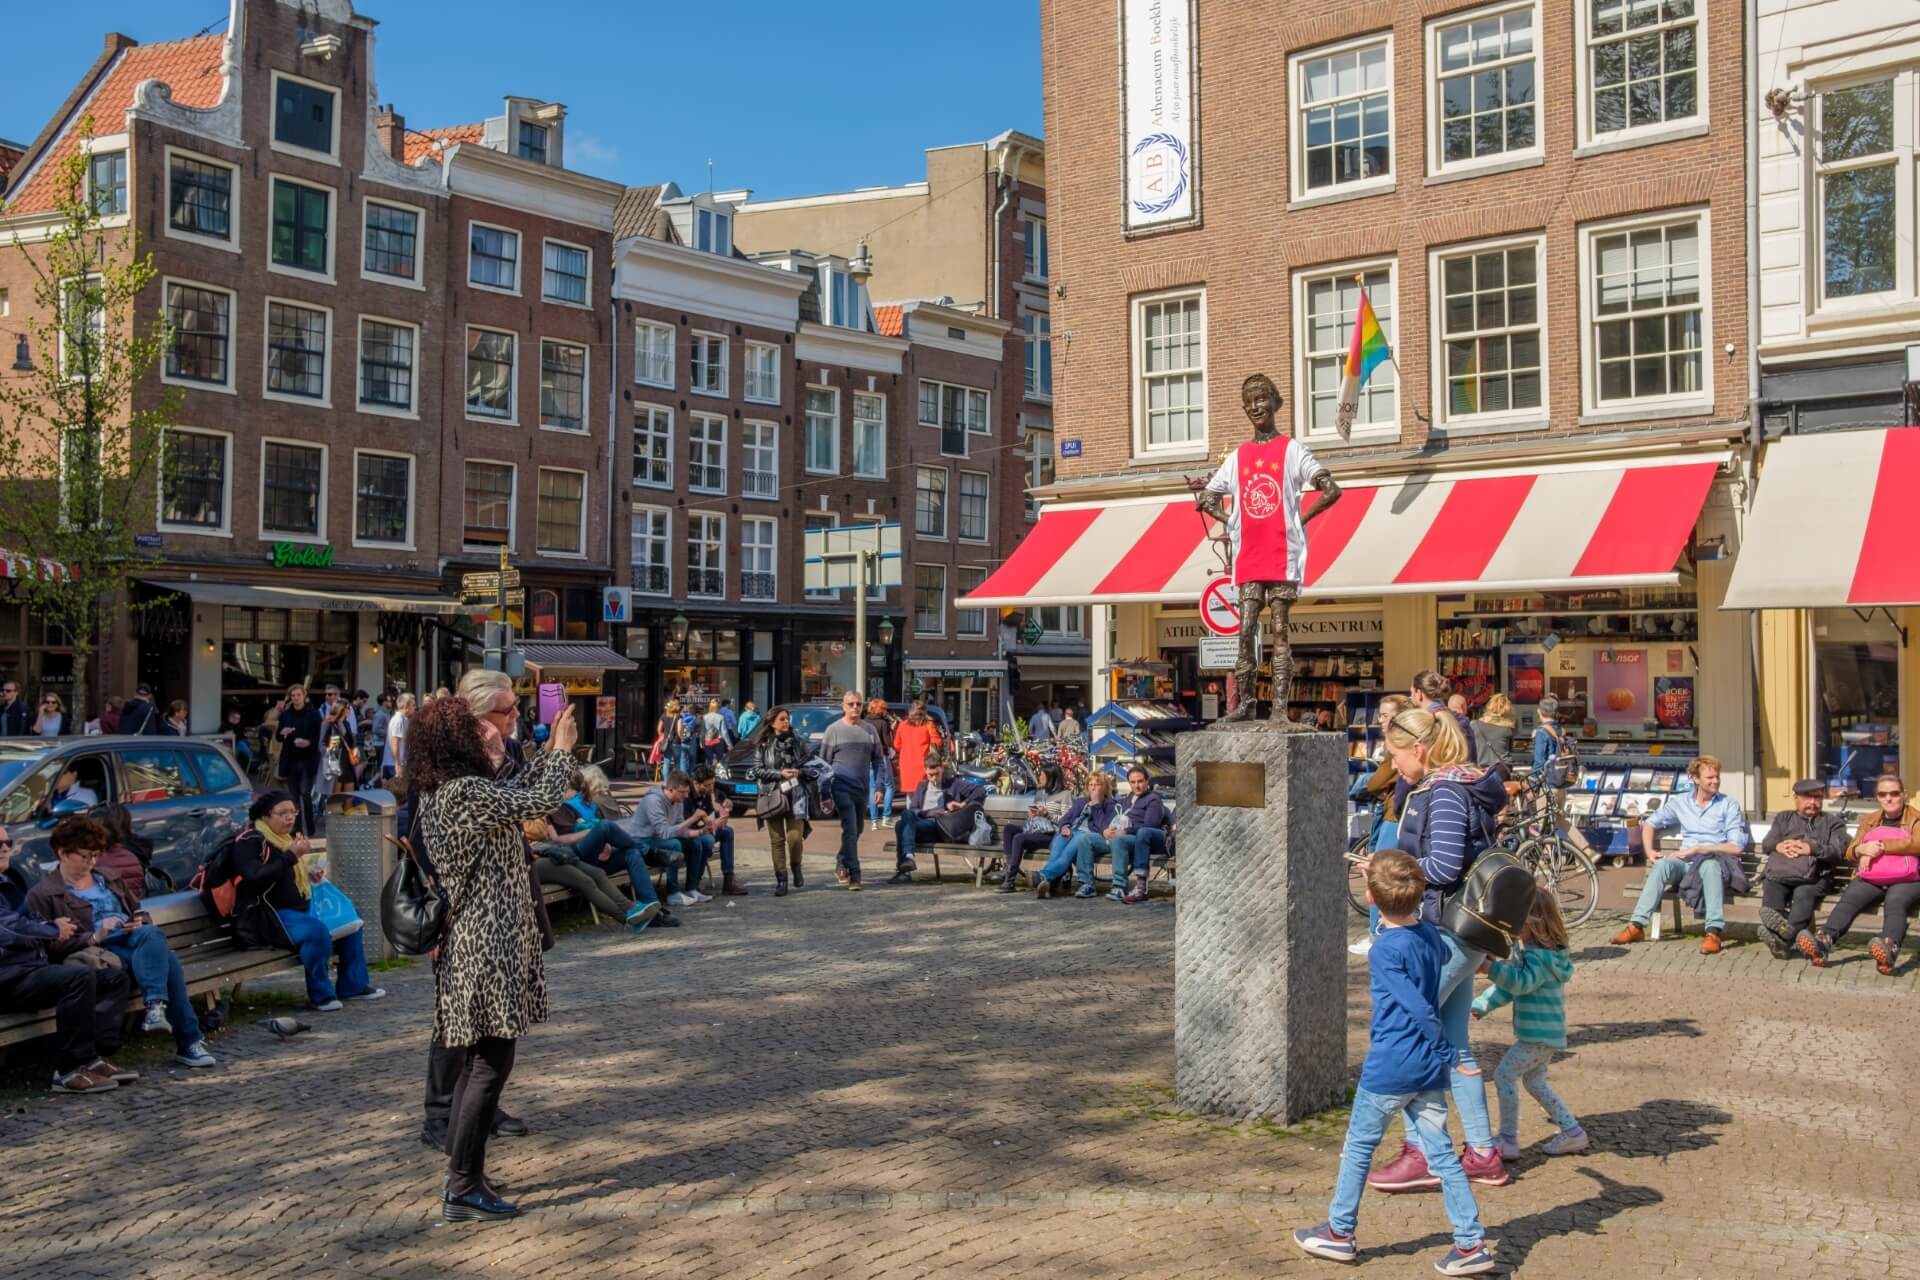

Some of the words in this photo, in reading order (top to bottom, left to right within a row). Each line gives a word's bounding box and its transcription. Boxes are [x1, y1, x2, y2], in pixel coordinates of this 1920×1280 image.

[1149, 0, 1161, 45] Boekh
[1150, 49, 1163, 127] Athenaeum
[1146, 154, 1162, 168] B
[1146, 178, 1162, 192] A
[274, 541, 335, 568] Grolsch
[1163, 625, 1209, 638] ATHEN
